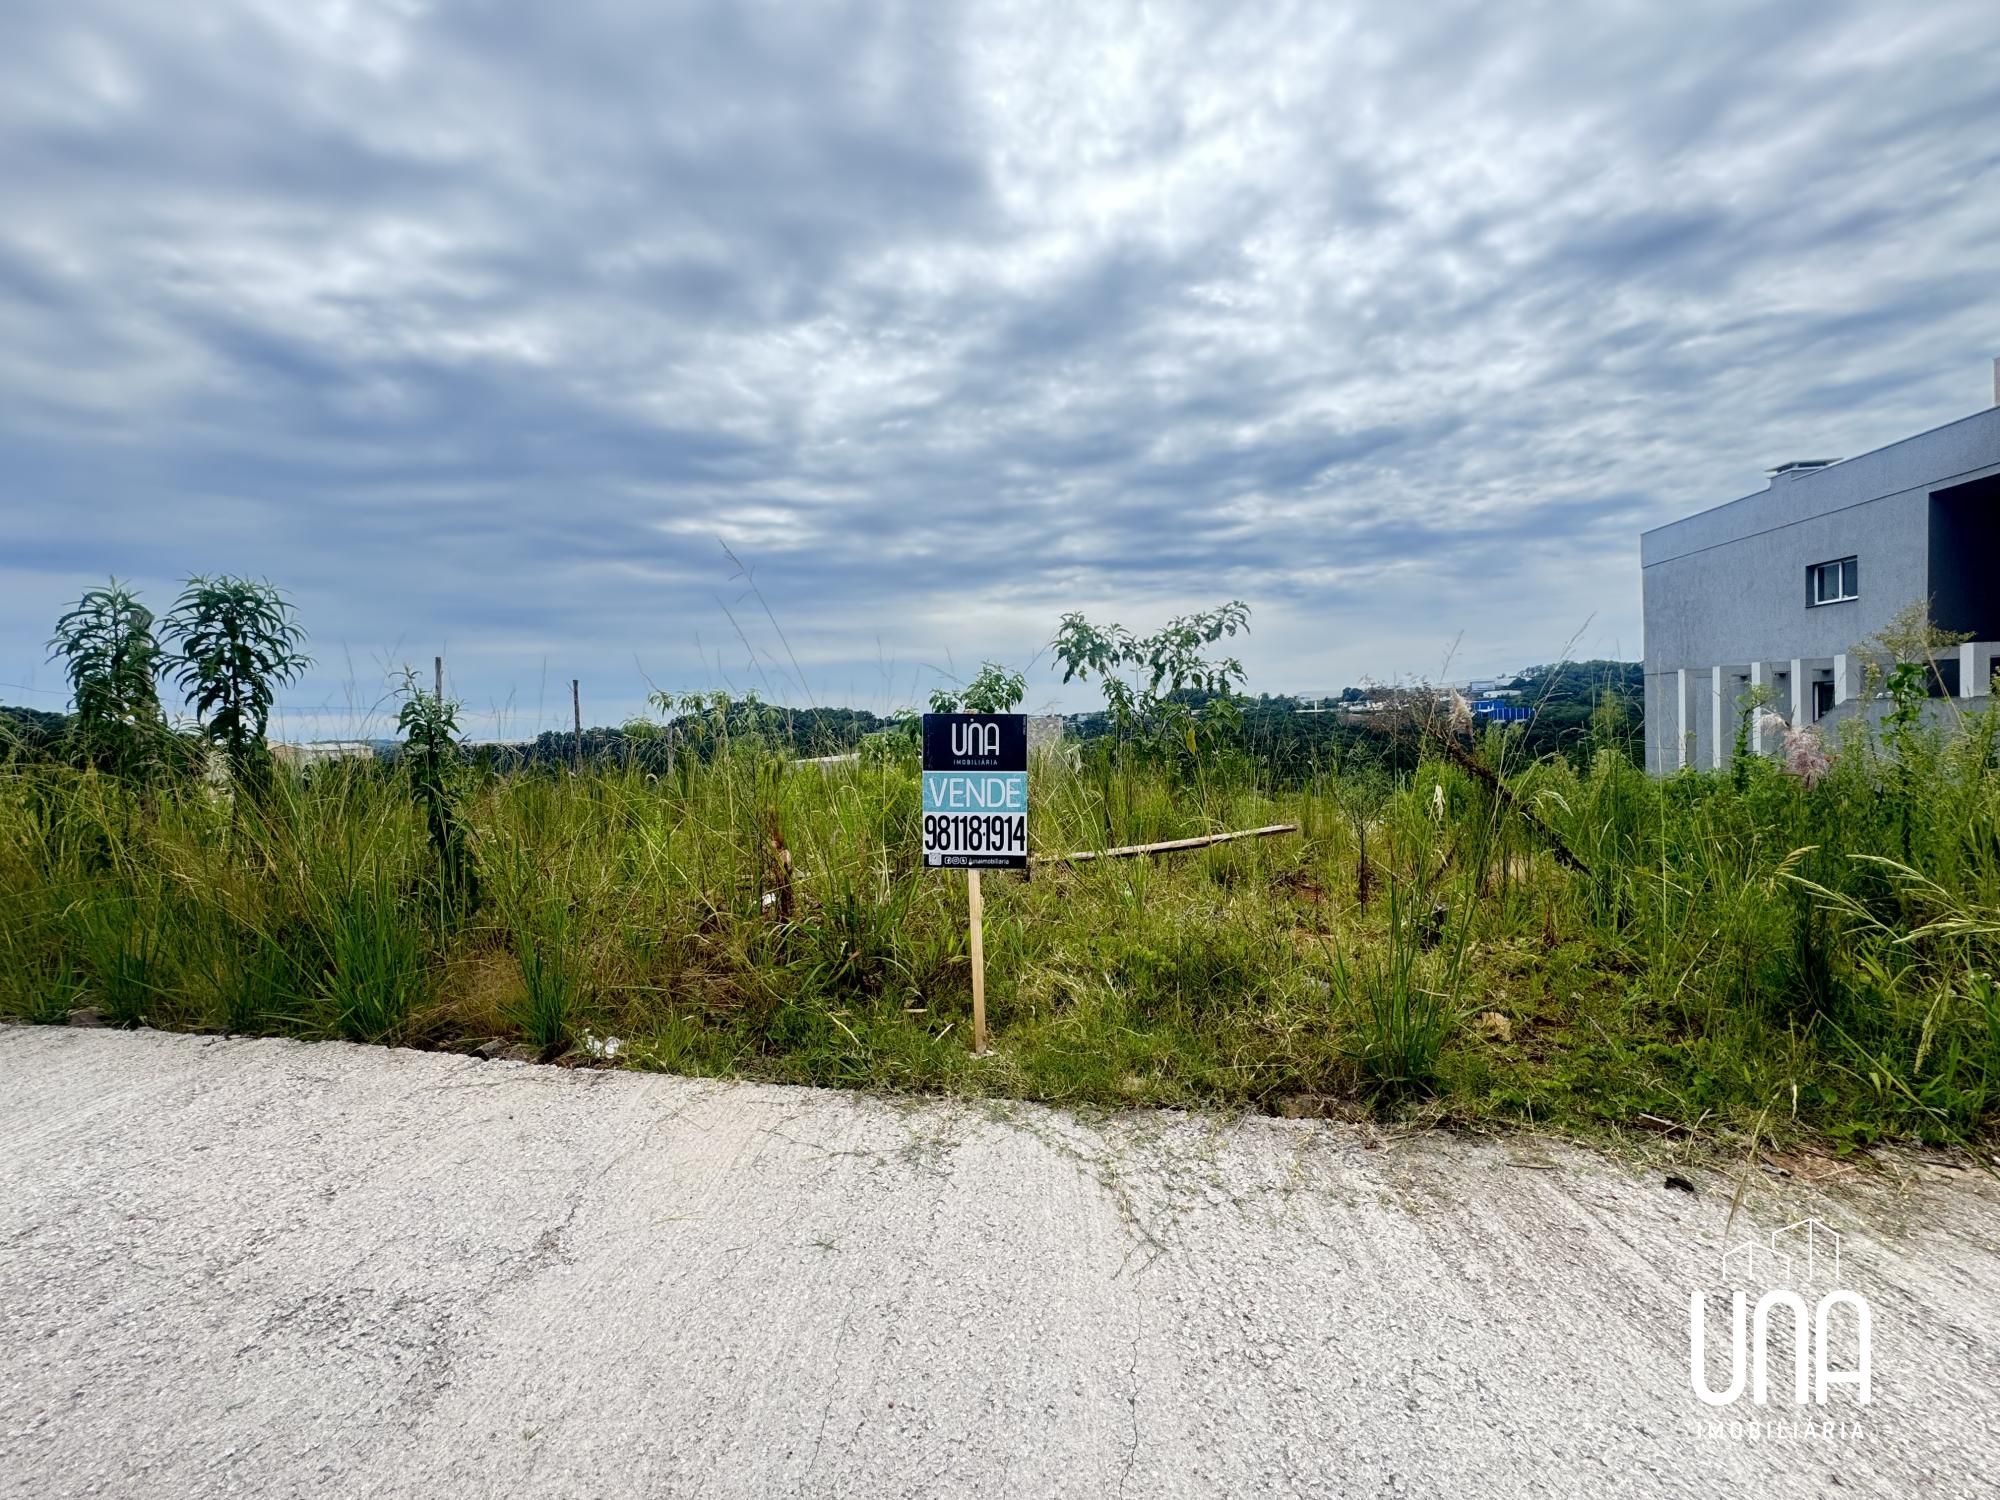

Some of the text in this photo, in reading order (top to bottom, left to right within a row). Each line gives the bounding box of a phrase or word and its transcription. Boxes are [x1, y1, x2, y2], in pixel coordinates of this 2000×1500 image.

[951, 722, 1000, 756] UNA
[953, 758, 998, 766] IMOBILIÁRIA
[928, 777, 1021, 808] VENDE
